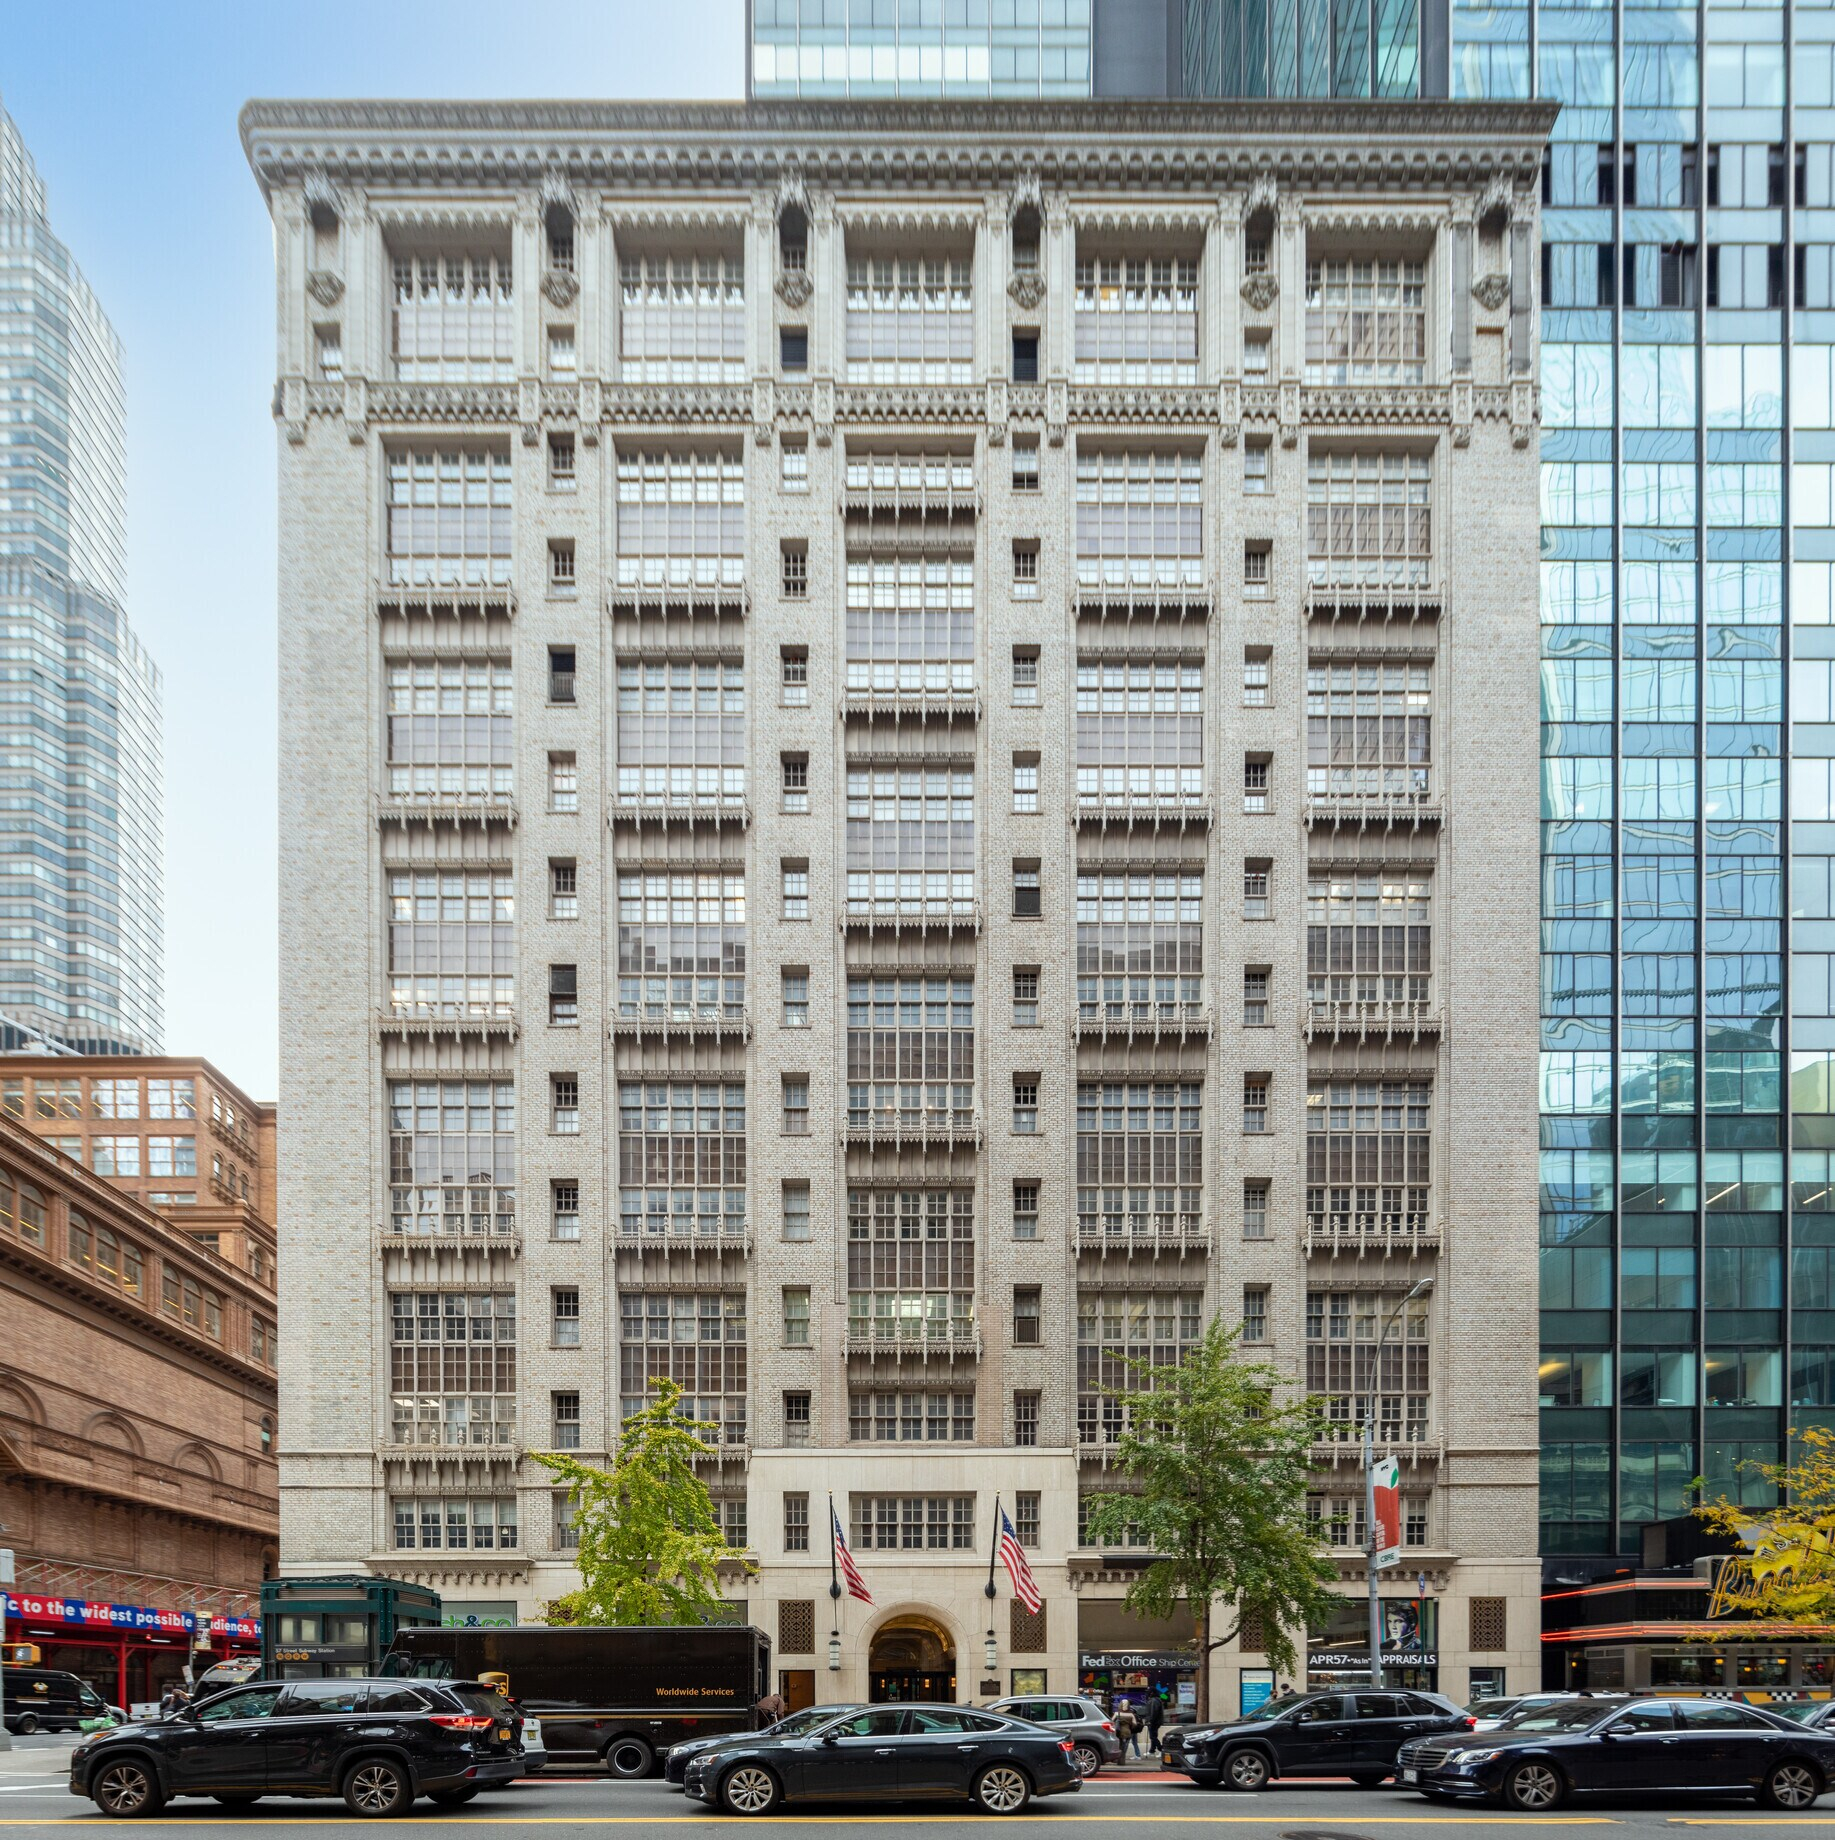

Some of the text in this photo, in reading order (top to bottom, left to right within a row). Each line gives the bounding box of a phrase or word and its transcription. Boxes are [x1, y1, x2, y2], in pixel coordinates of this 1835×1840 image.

[1380, 1552, 1395, 1563] CBRE
[22, 1599, 42, 1613] to
[46, 1601, 76, 1616] the
[79, 1605, 132, 1622] widest
[136, 1613, 193, 1627] possible
[211, 1618, 252, 1635] dience,
[1082, 1655, 1200, 1669] FedEx Office Ship Cente
[1378, 1654, 1436, 1665] APPRAISALS
[655, 1687, 735, 1696] Worldwide Services
